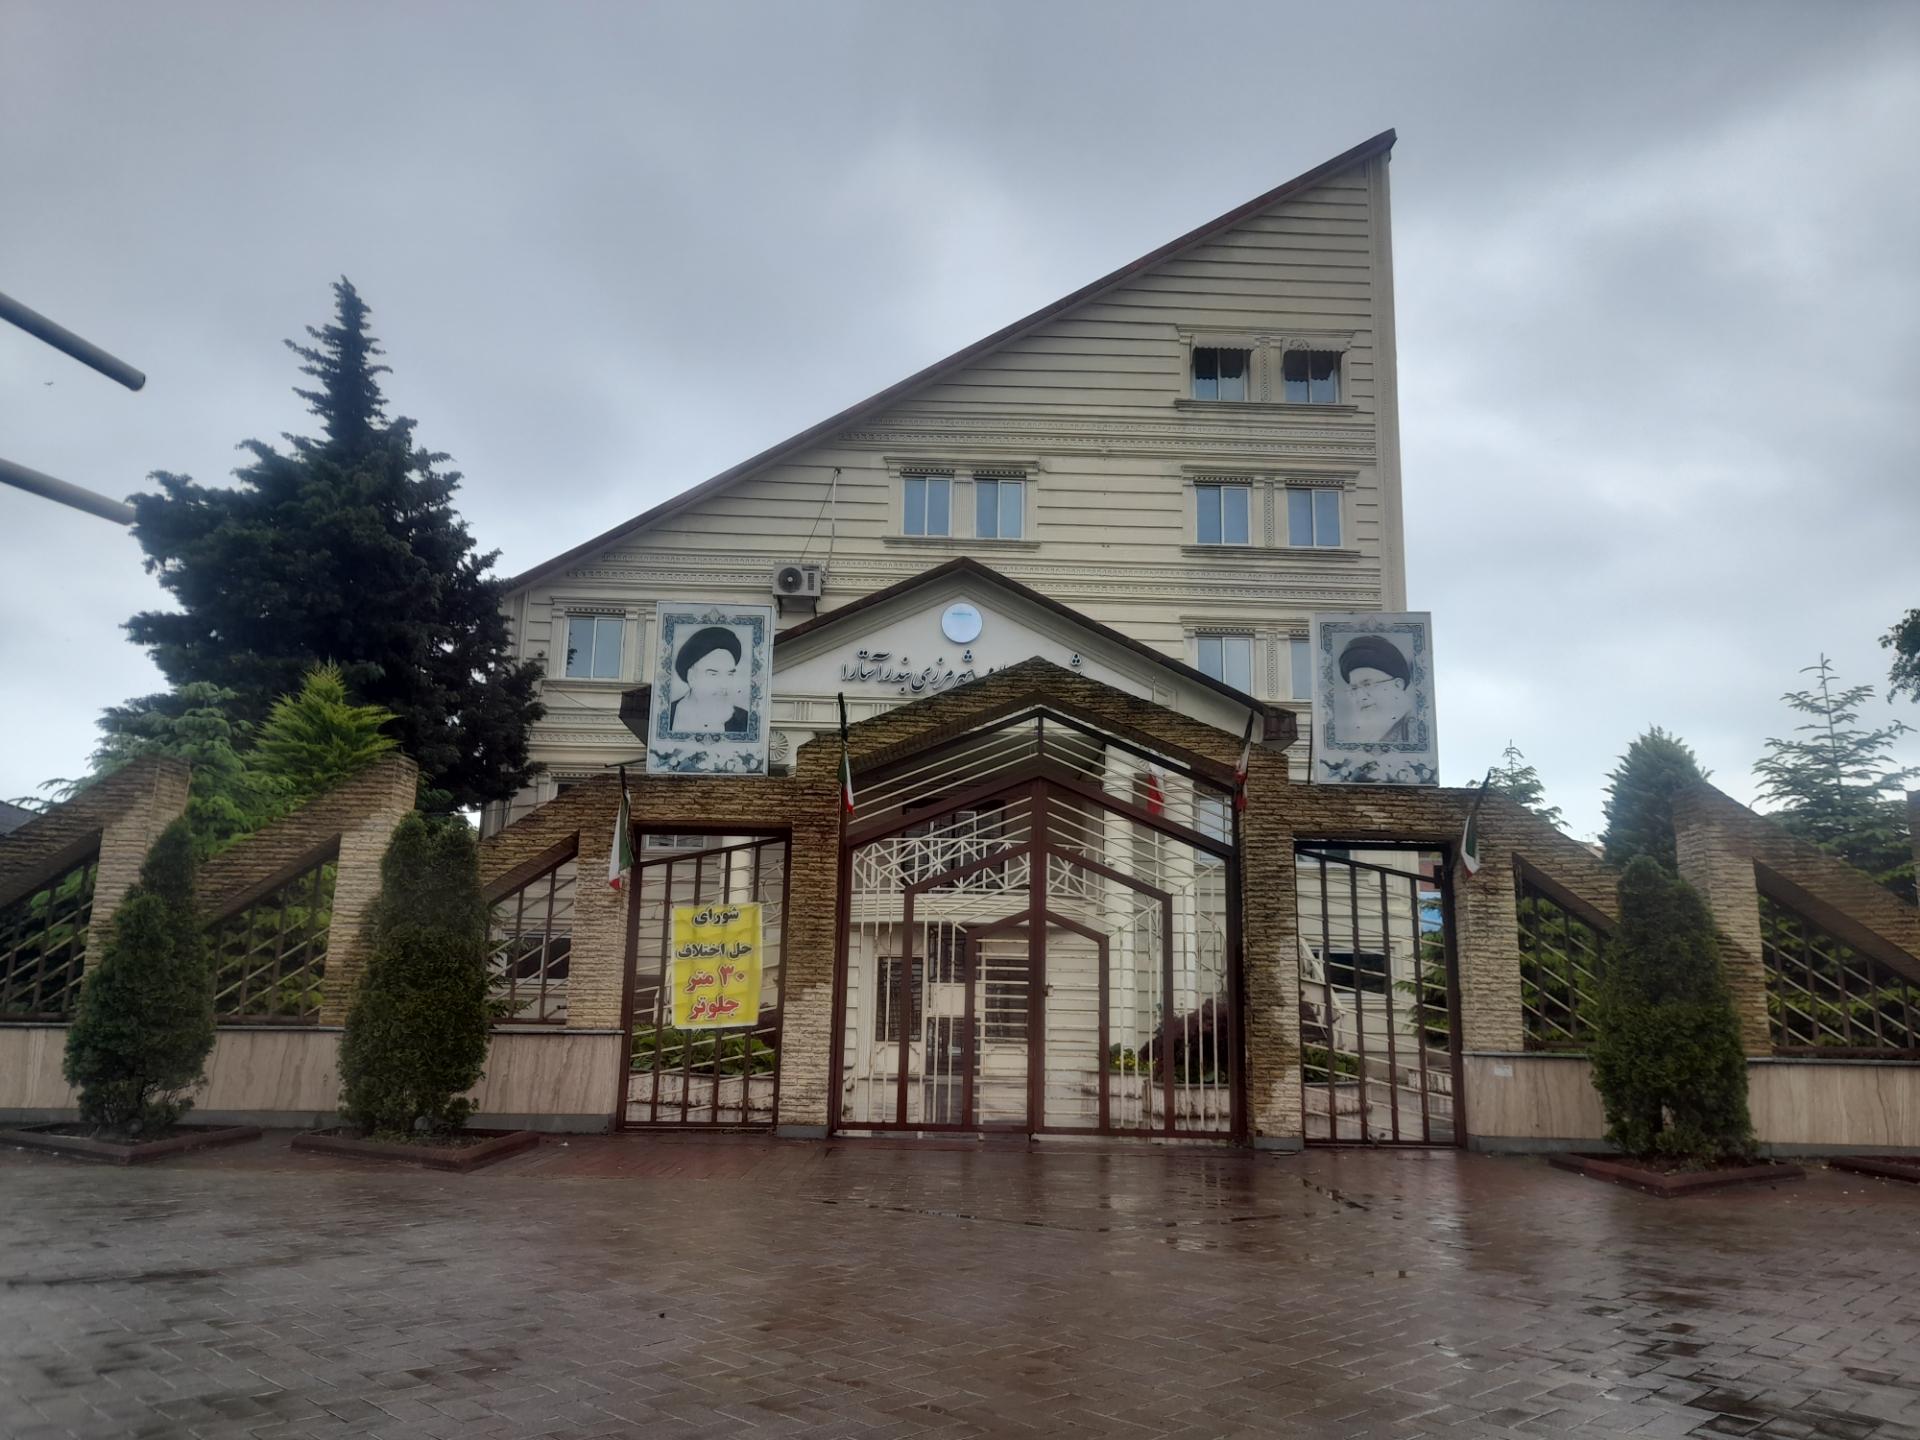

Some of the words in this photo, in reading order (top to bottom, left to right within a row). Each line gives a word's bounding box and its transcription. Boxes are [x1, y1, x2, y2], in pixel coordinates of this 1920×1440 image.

[841, 648, 891, 682] آستارا
[882, 656, 913, 694] بندر
[910, 656, 954, 692] مرزی
[694, 906, 740, 926] شورای
[677, 942, 725, 958] اختلاف
[728, 942, 752, 958] حل
[686, 971, 715, 993] متر
[719, 964, 745, 987] ۳۰
[688, 994, 740, 1020] جلوتر
